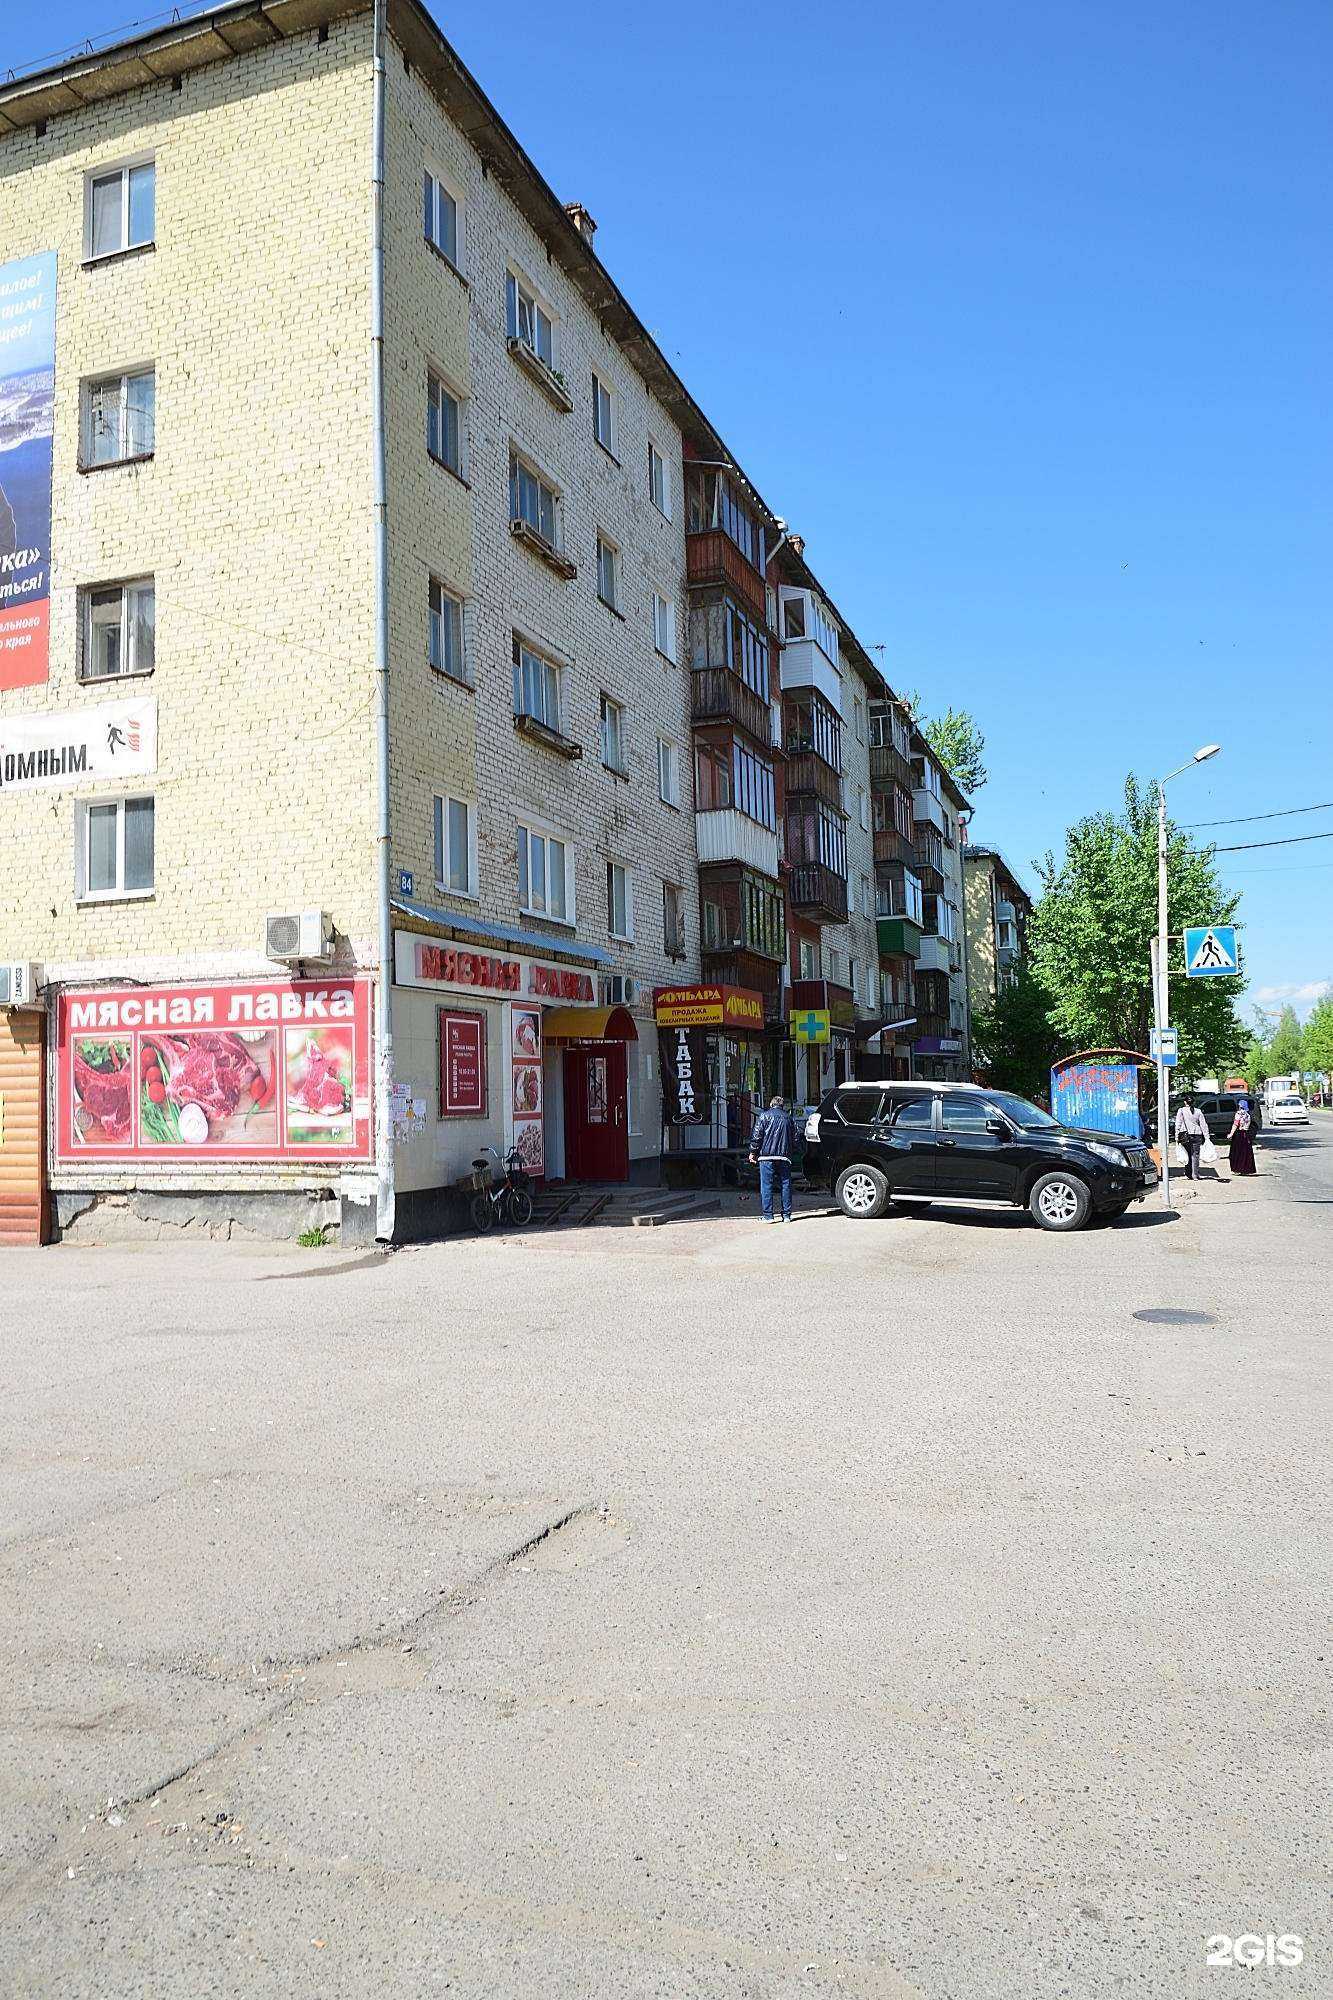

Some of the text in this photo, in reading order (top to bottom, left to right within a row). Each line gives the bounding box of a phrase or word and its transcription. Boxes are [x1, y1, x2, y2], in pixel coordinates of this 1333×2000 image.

[0, 547, 41, 573] ка»
[0, 744, 94, 786] ОМНЫМ.
[401, 876, 411, 891] 84
[415, 943, 521, 992] МЯСНАЯ
[70, 988, 355, 1028] мясная лавка
[671, 1009, 707, 1017] ПРОДАЖА
[674, 1027, 696, 1114] ТАБАК
